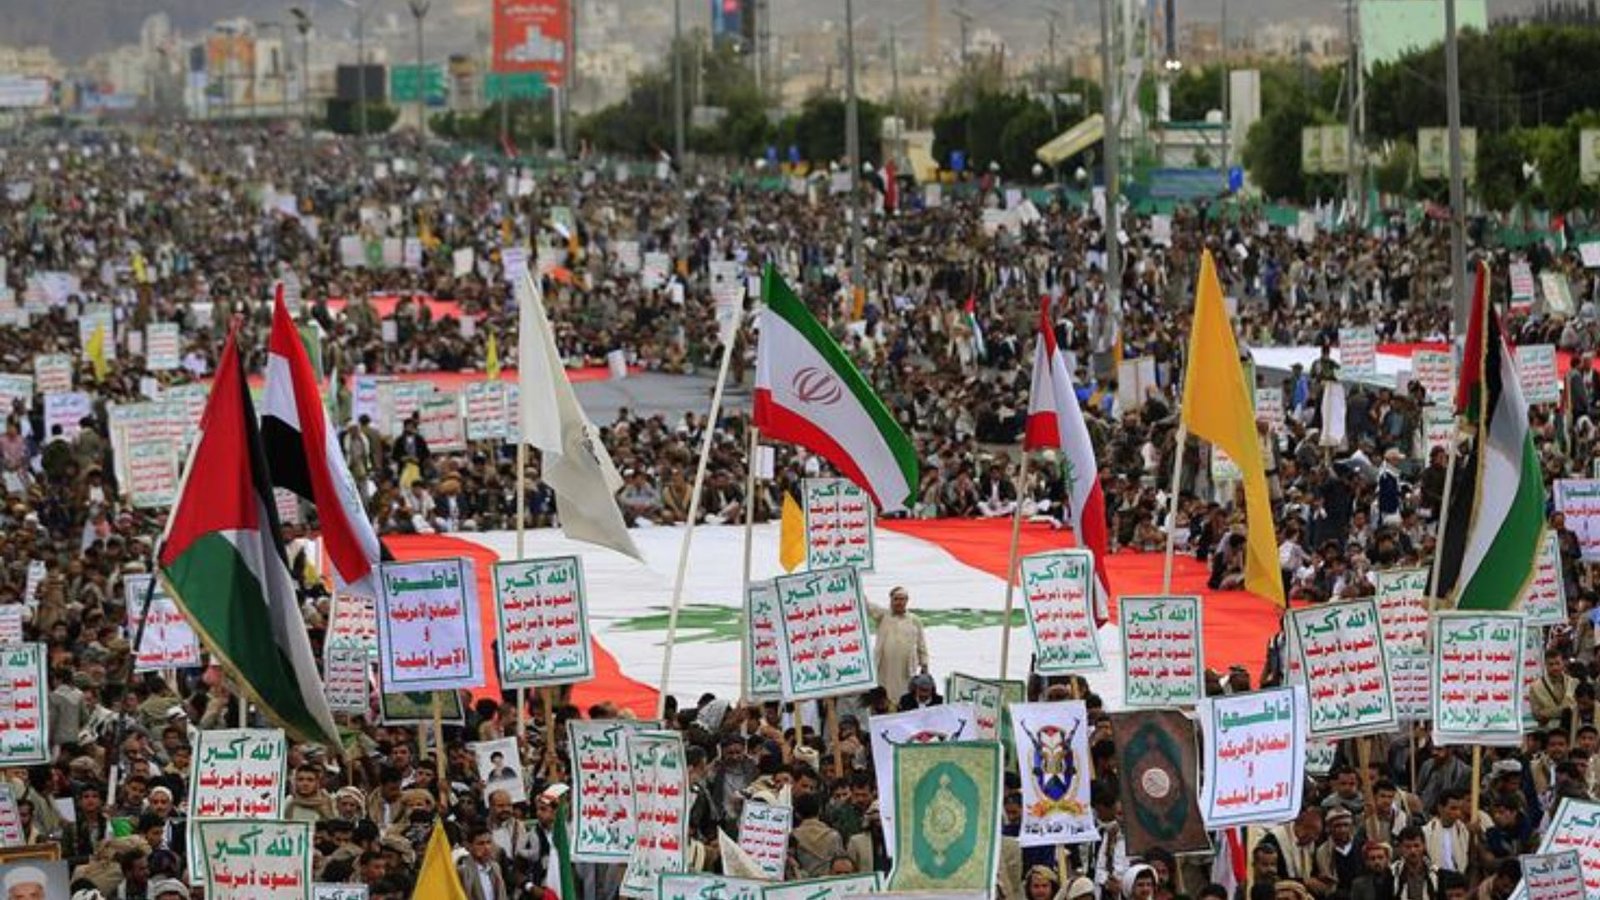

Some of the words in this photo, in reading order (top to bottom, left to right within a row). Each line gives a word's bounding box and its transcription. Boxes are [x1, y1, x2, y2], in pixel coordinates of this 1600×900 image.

[546, 565, 574, 583] الله
[826, 573, 853, 592] الله
[1168, 604, 1192, 621] الله
[1345, 606, 1374, 627] الله
[1490, 623, 1516, 640] الله
[1344, 633, 1377, 652] الموت
[1347, 654, 1380, 674] الموت
[250, 737, 279, 760] الله
[245, 771, 278, 789] الموت
[244, 797, 278, 815] الموت
[264, 827, 302, 856] الله
[260, 869, 300, 889] الموت
